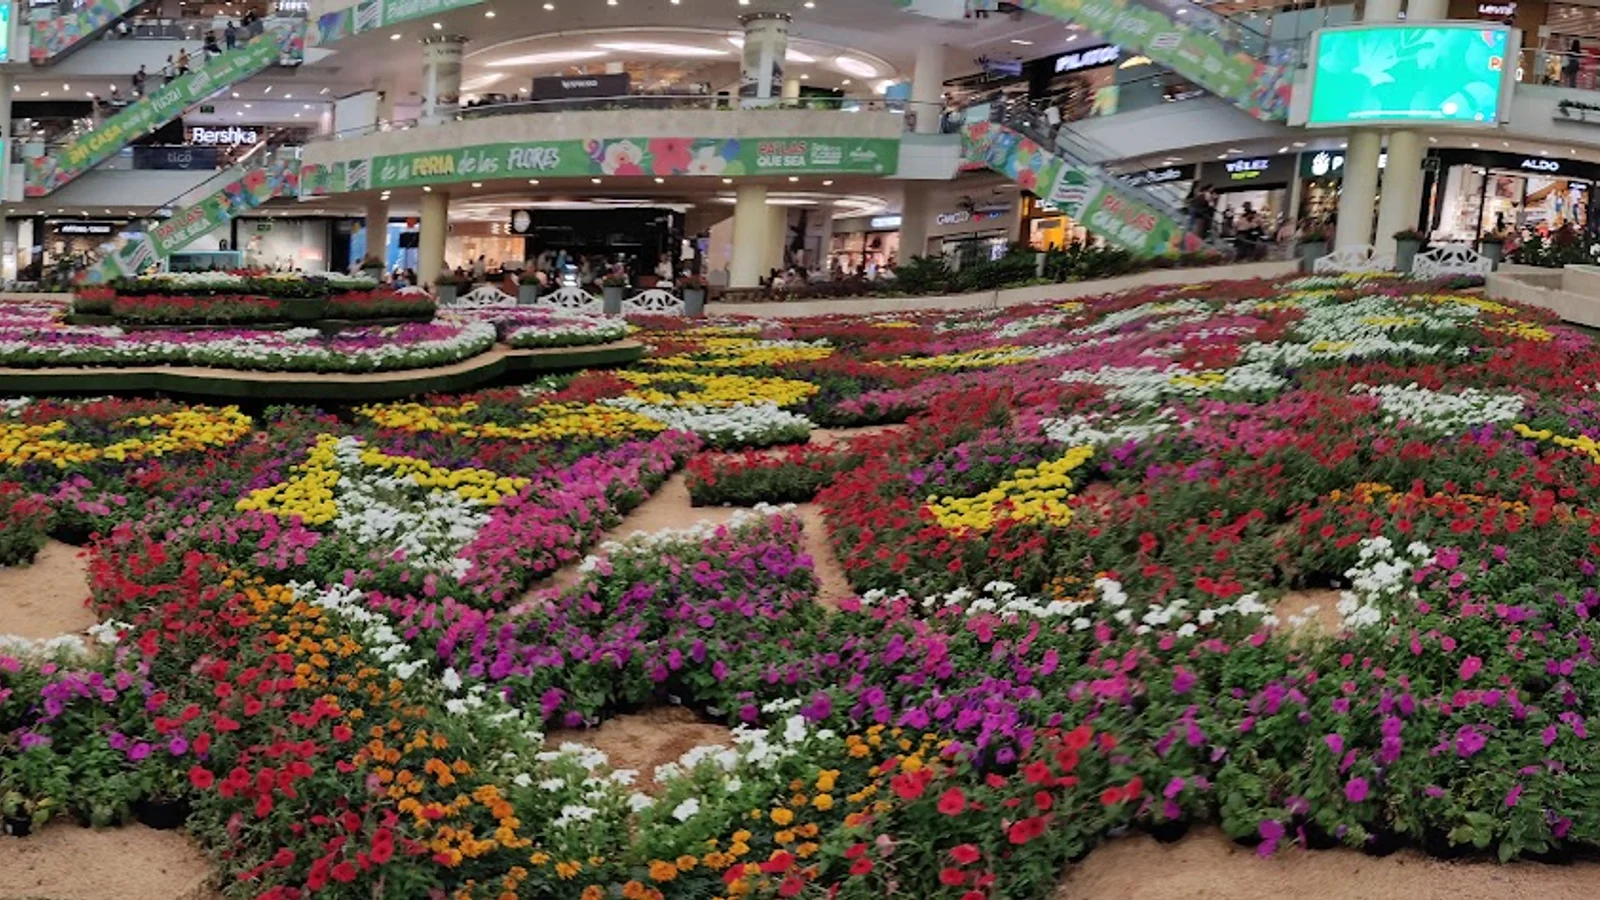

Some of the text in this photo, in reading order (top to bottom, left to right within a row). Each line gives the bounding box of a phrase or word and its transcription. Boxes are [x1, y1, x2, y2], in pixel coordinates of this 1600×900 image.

[193, 127, 256, 145] Bershka
[381, 146, 560, 182] de la FERIA de las FLORES
[757, 156, 807, 167] QUE SEA
[1521, 160, 1560, 171] ALDO
